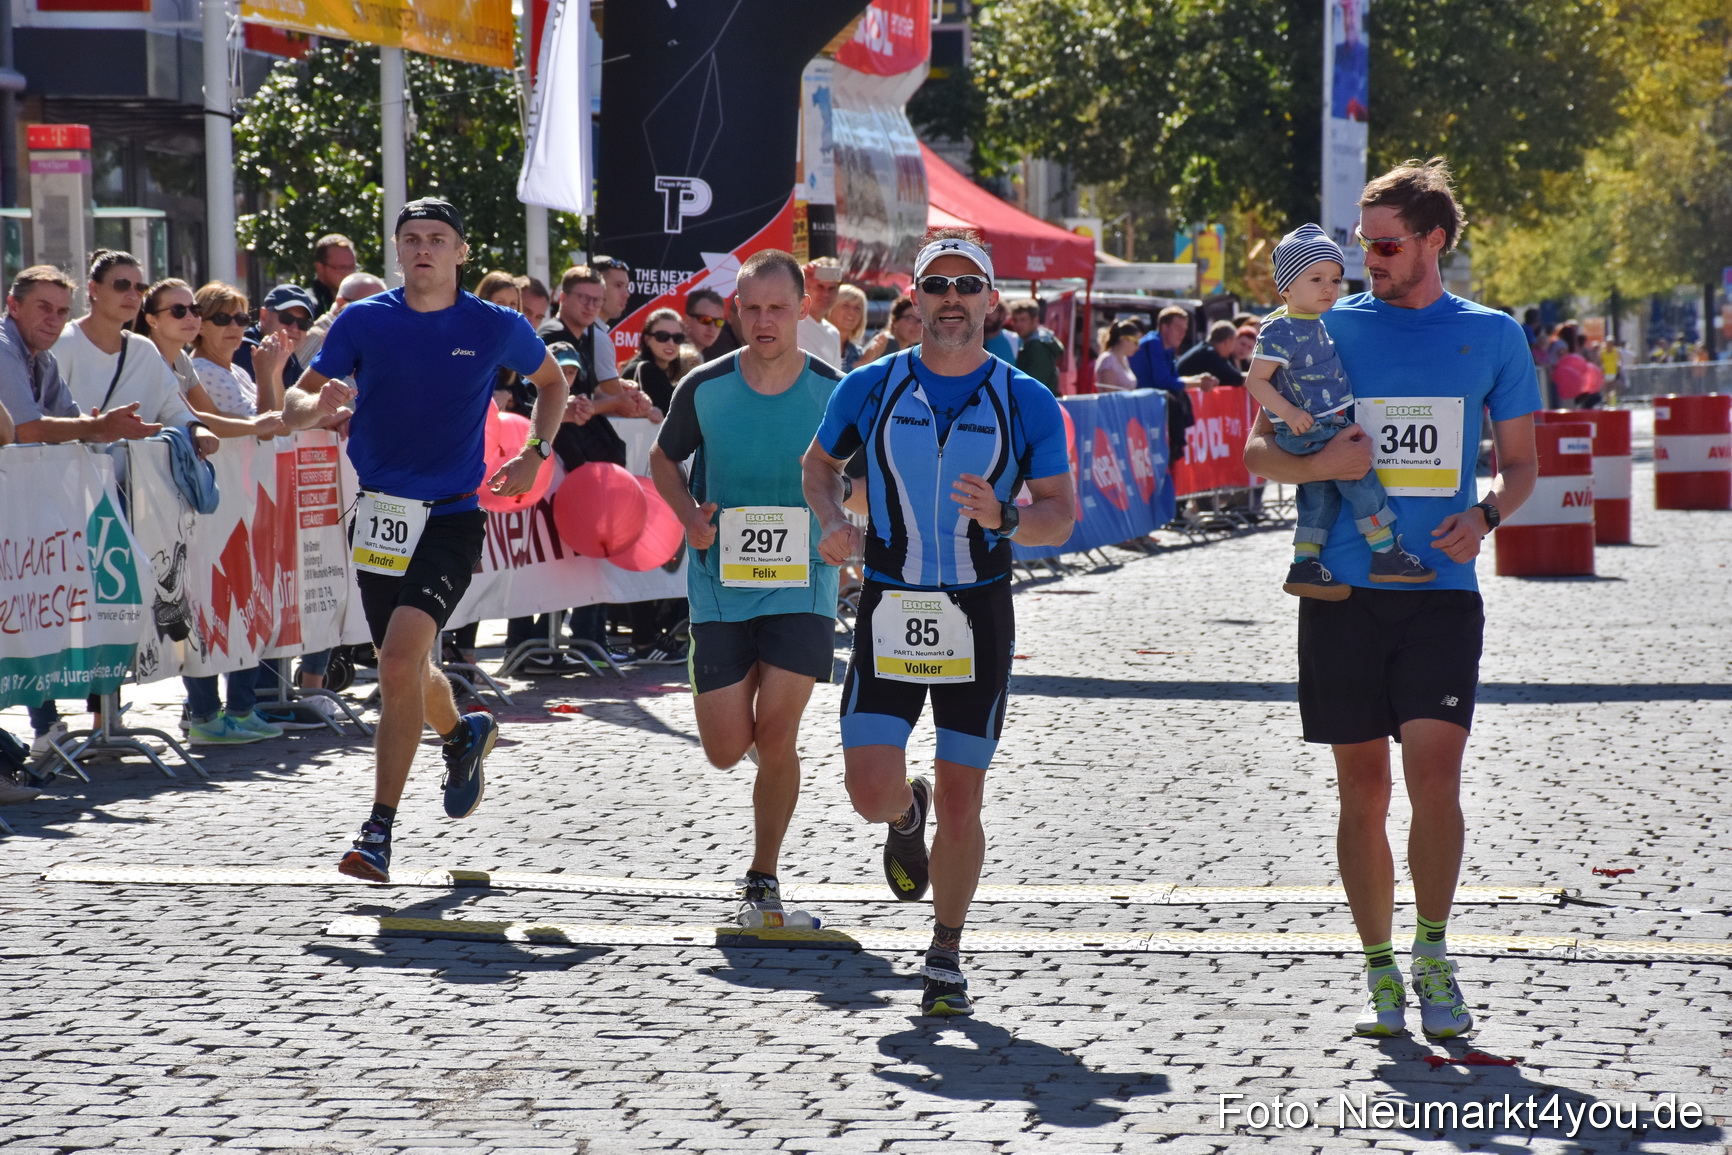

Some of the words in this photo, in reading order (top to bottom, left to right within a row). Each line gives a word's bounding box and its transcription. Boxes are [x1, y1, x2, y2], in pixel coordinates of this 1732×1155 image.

[635, 268, 657, 281] THE
[666, 269, 695, 283] NEXT
[637, 281, 678, 296] YEARS
[614, 331, 642, 348] BM
[1386, 406, 1432, 416] BOCK
[1380, 424, 1438, 454] 340
[374, 500, 407, 515] BOCK
[745, 513, 784, 522] BOCK
[369, 515, 408, 544] 130
[379, 543, 401, 553] Neumarkt
[741, 528, 788, 553] 297
[368, 553, 395, 567] André
[752, 567, 777, 578] Felix
[902, 600, 943, 611] BOCK
[905, 618, 940, 646] 85
[904, 662, 943, 675] Volker
